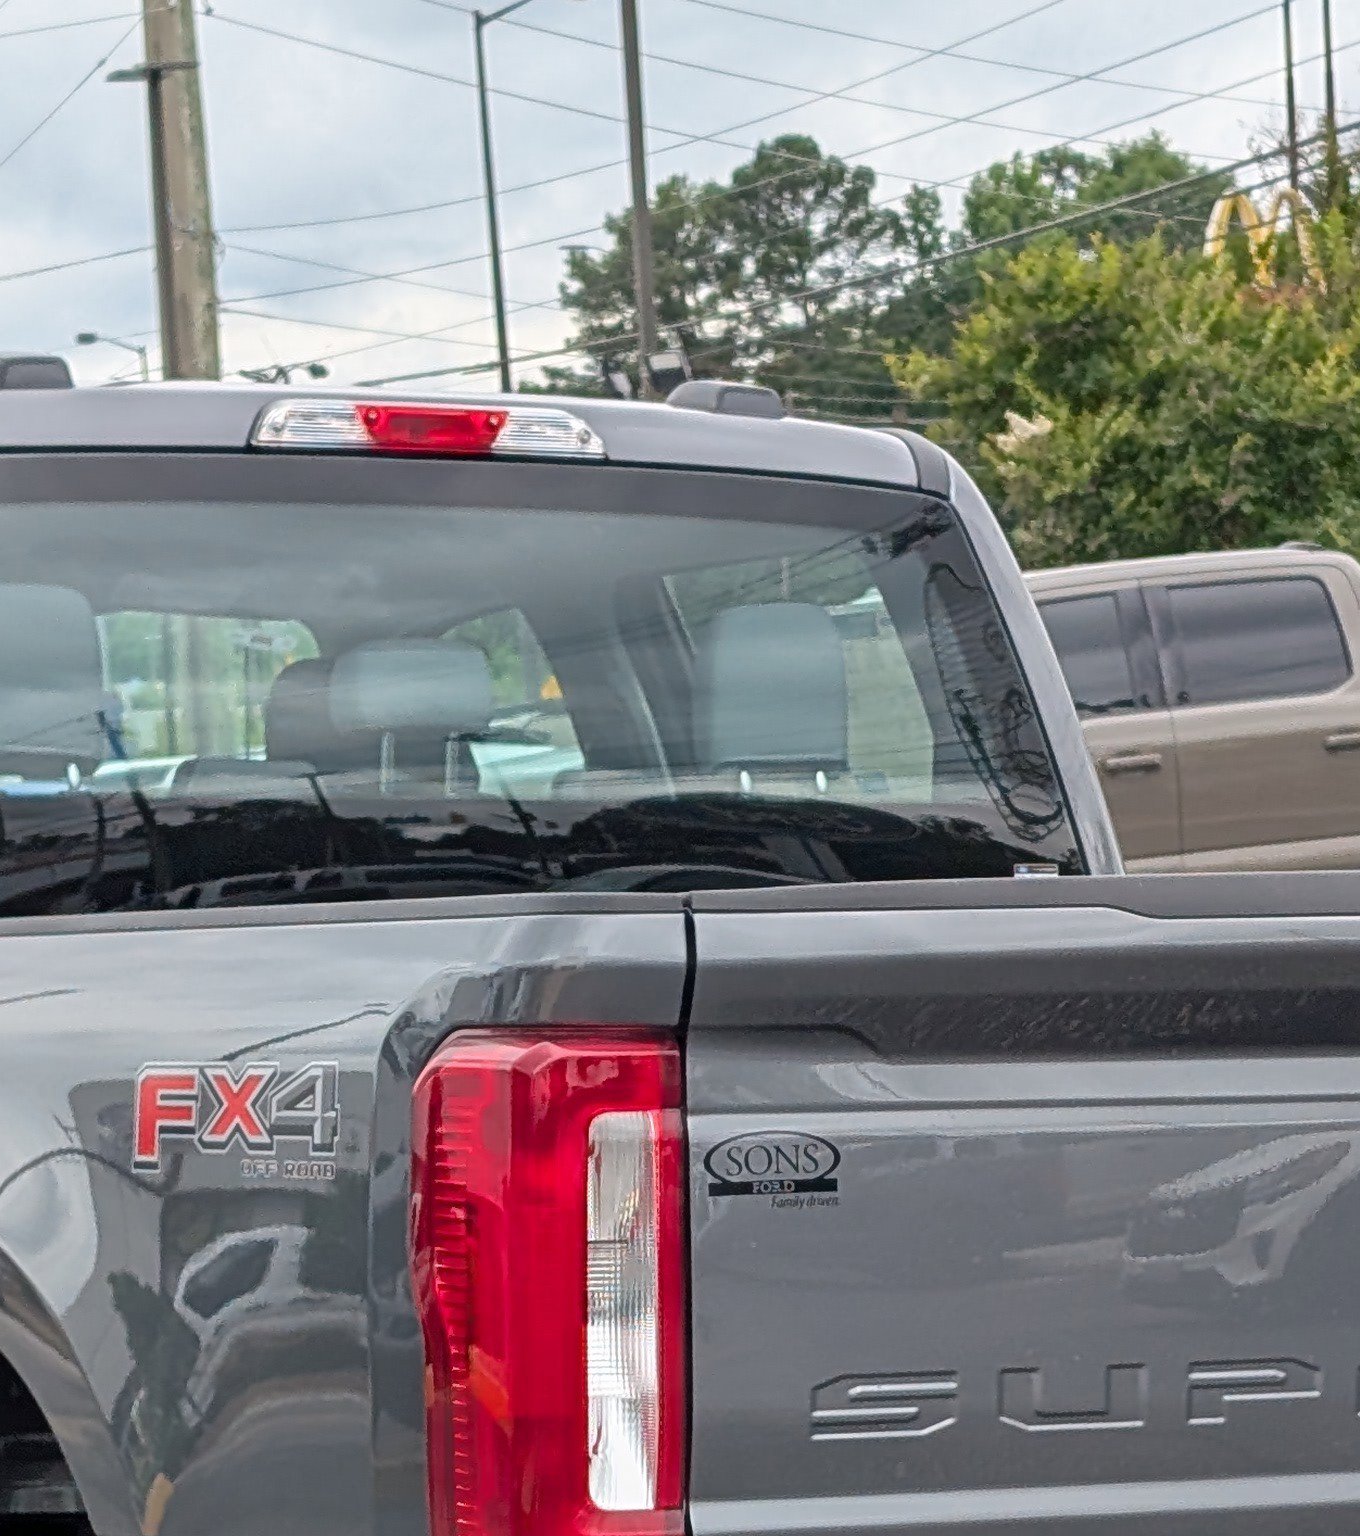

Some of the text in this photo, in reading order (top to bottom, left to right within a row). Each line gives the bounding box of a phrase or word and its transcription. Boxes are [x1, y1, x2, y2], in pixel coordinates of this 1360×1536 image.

[131, 1060, 341, 1173] FX4
[240, 1159, 279, 1179] OFF
[725, 1143, 820, 1176] SONS
[751, 1180, 796, 1194] FORD
